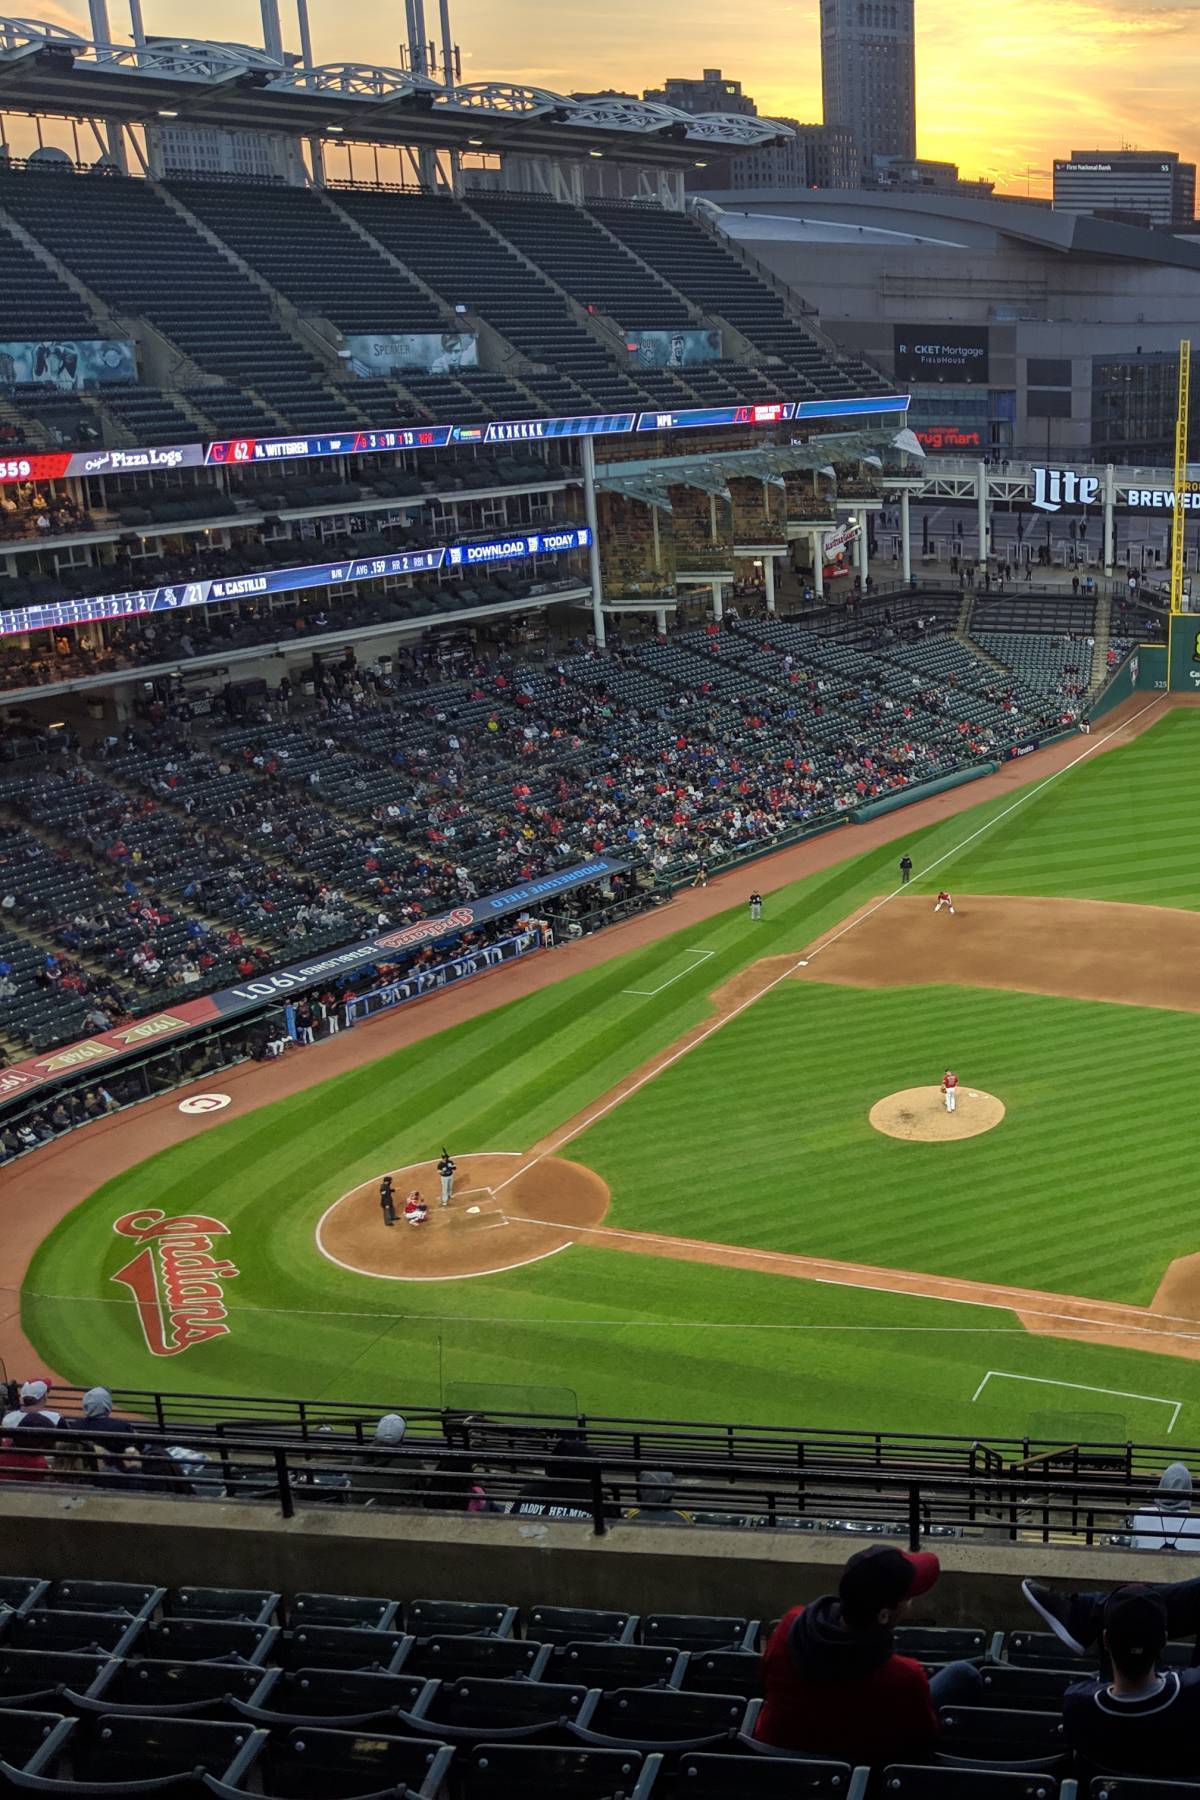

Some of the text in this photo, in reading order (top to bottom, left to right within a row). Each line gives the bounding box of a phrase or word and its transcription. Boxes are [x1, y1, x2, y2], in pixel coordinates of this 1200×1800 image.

[900, 345, 984, 356] RCKET Mortgage
[235, 442, 249, 460] 62
[266, 442, 308, 456] WITTGREN
[915, 432, 979, 447] rug mart
[85, 452, 110, 471] Original
[111, 452, 149, 467] Pizza
[149, 449, 183, 467] Logs
[1032, 468, 1099, 512] Lite
[467, 534, 574, 559] DOWNLOAD TODAY
[355, 557, 408, 576] AVG .159 2
[189, 578, 267, 602] 21 W. CASTILLO
[489, 862, 610, 908] FIELD PROGRESSIVE
[374, 907, 474, 949] Indians
[300, 945, 379, 976] ESTABLISHED
[231, 970, 308, 1002] 1901
[136, 1019, 177, 1036] 1920
[64, 1045, 97, 1065] 1948
[111, 1207, 241, 1350] Indians
[520, 1503, 545, 1515] DADDY
